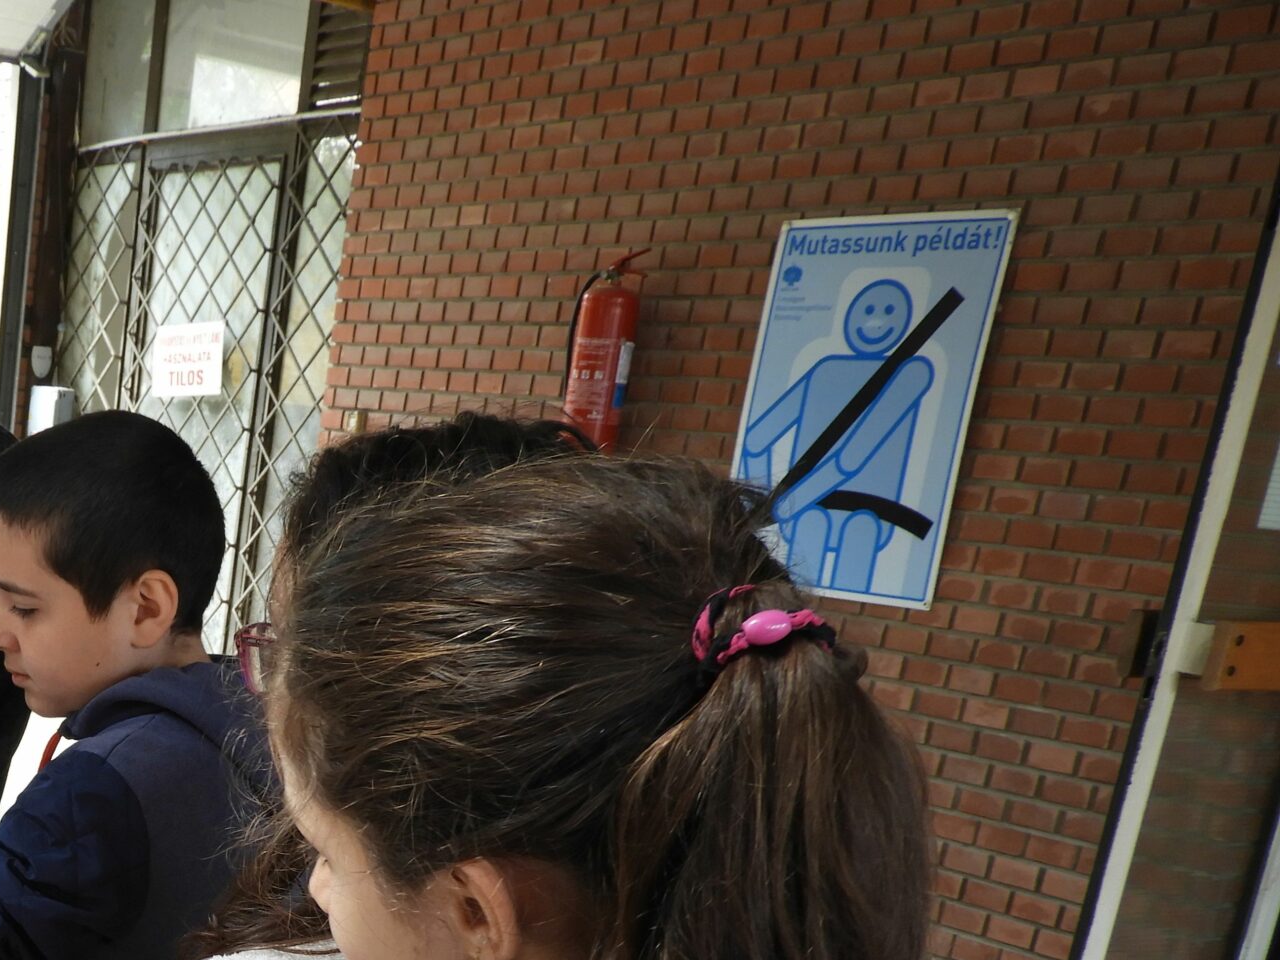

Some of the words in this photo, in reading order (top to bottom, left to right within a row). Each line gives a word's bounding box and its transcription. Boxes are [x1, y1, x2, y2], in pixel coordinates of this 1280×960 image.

[789, 231, 907, 255] Mutassunk
[913, 225, 1003, 257] példát!
[169, 370, 204, 386] TILOS
